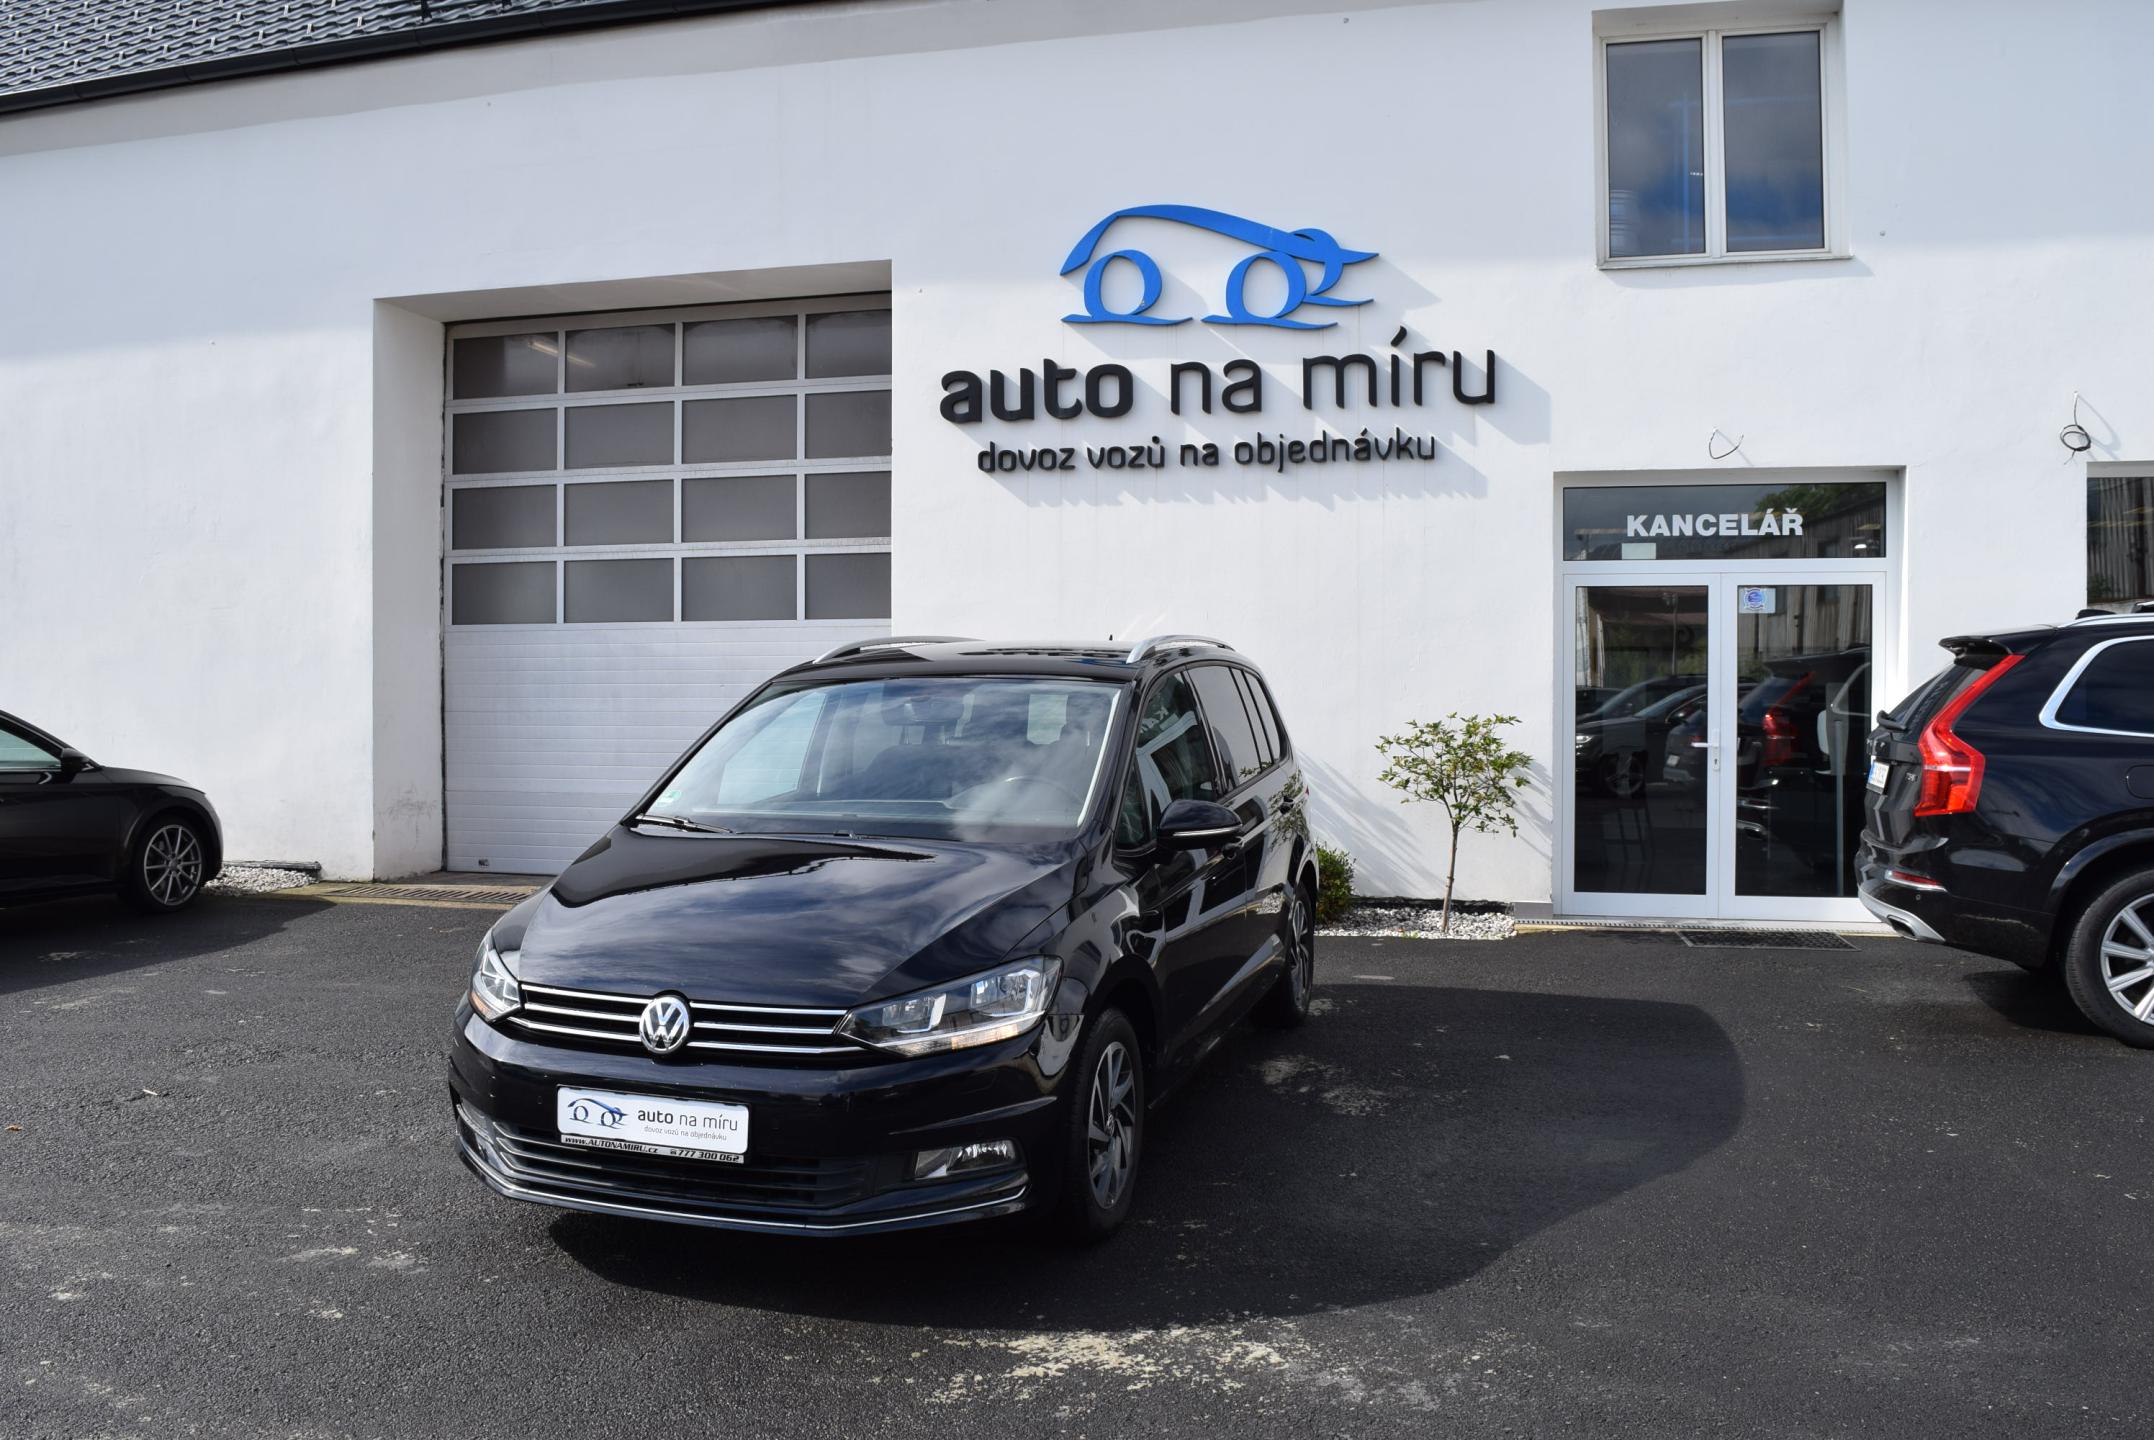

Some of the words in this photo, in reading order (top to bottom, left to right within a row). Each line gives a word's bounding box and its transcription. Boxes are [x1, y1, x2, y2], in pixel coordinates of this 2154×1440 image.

[940, 358, 1134, 424] auto
[1170, 357, 1262, 415] na
[1303, 326, 1496, 410] míru
[977, 441, 1076, 473] dovoz
[1087, 435, 1165, 469] vozů
[1180, 441, 1219, 468] na
[1234, 427, 1435, 473] objednávku
[1626, 507, 1803, 537] KANCELÁŘ
[637, 1109, 674, 1124] auto
[679, 1114, 697, 1127] na
[703, 1114, 738, 1131] míru
